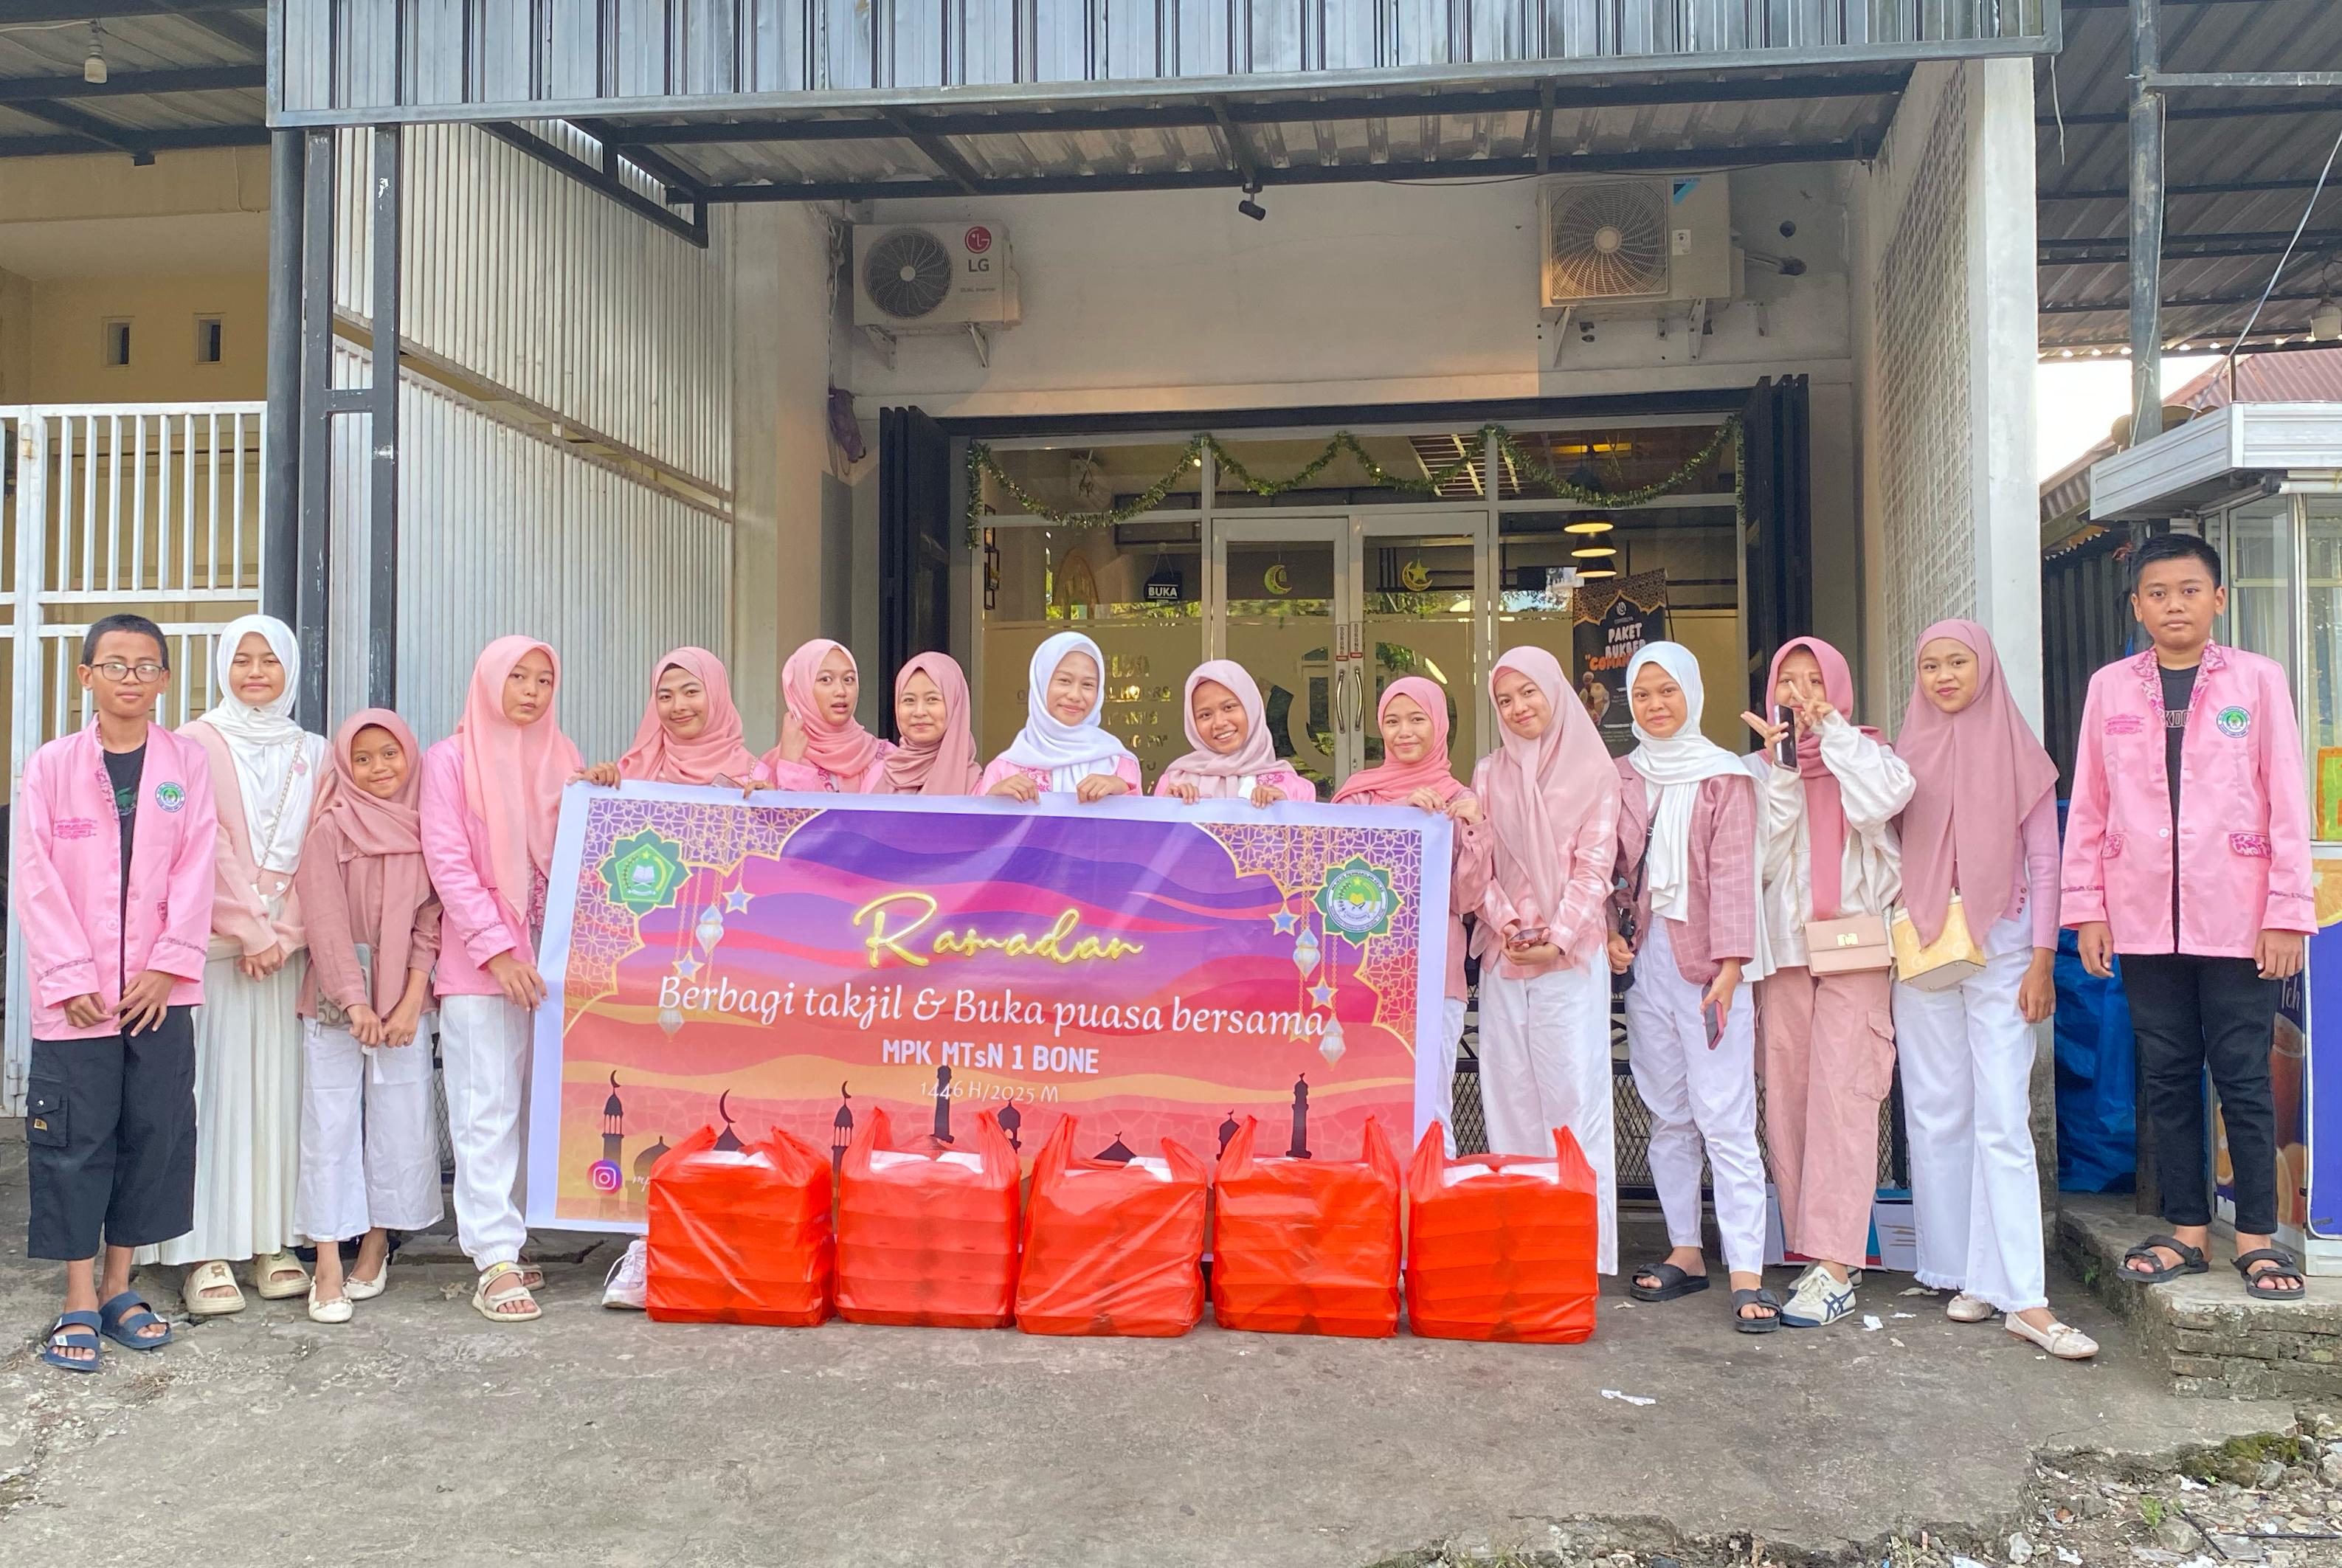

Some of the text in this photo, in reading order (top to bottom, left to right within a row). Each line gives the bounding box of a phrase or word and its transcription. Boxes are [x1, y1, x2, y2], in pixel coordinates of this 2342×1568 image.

[968, 258, 989, 272] LG
[1148, 587, 1178, 597] BUKA
[1608, 622, 1642, 643] PAKET
[853, 891, 1144, 968] Ramadan
[658, 975, 1325, 1037] Berbagi takjil & Buka puasa bersama
[882, 1039, 1099, 1074] MPK MTsN 1 BONE
[920, 1080, 1059, 1105] 1446 H/2025 M
